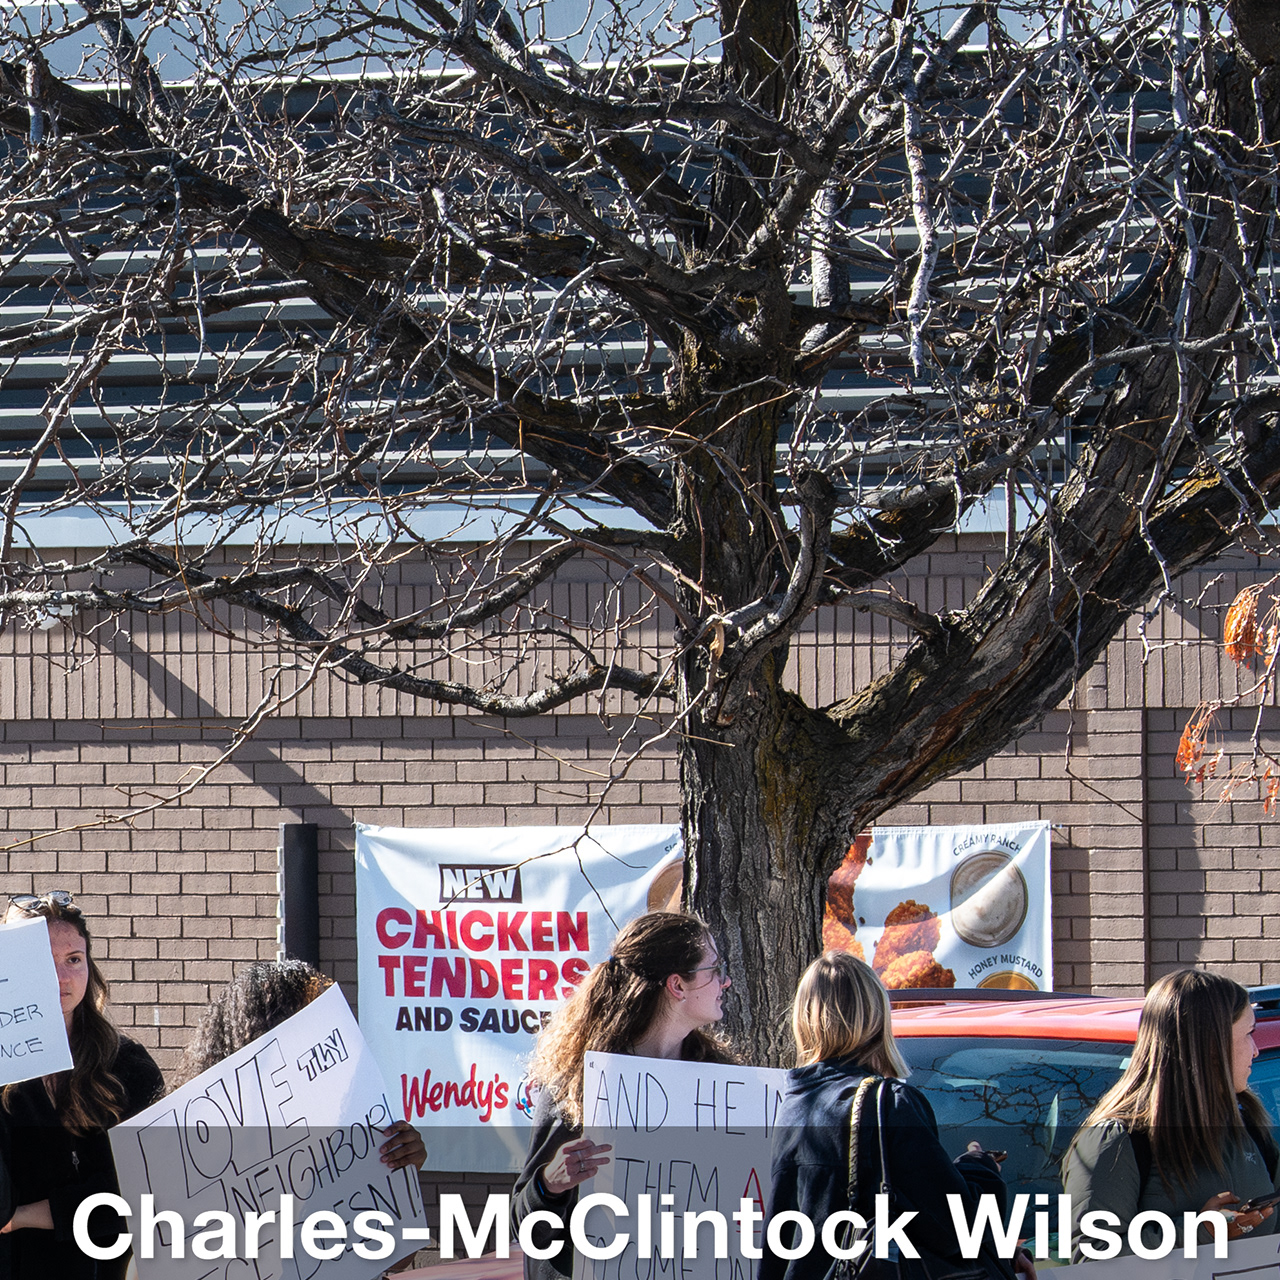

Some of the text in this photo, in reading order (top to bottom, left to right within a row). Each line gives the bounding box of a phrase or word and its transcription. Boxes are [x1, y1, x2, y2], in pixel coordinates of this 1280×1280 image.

[953, 833, 1022, 857] CREAMY RANCH
[442, 867, 518, 899] NEW
[375, 907, 590, 952] CHICKEN
[378, 954, 591, 1001] TENDERS
[968, 954, 1043, 980] HONEY MUSTARD
[395, 1006, 454, 1032] AND
[400, 1063, 509, 1123] Wendy's
[591, 1069, 669, 1134] AND
[694, 1078, 746, 1136] HE
[137, 1037, 310, 1247] LOVE
[615, 1157, 719, 1219] THEM
